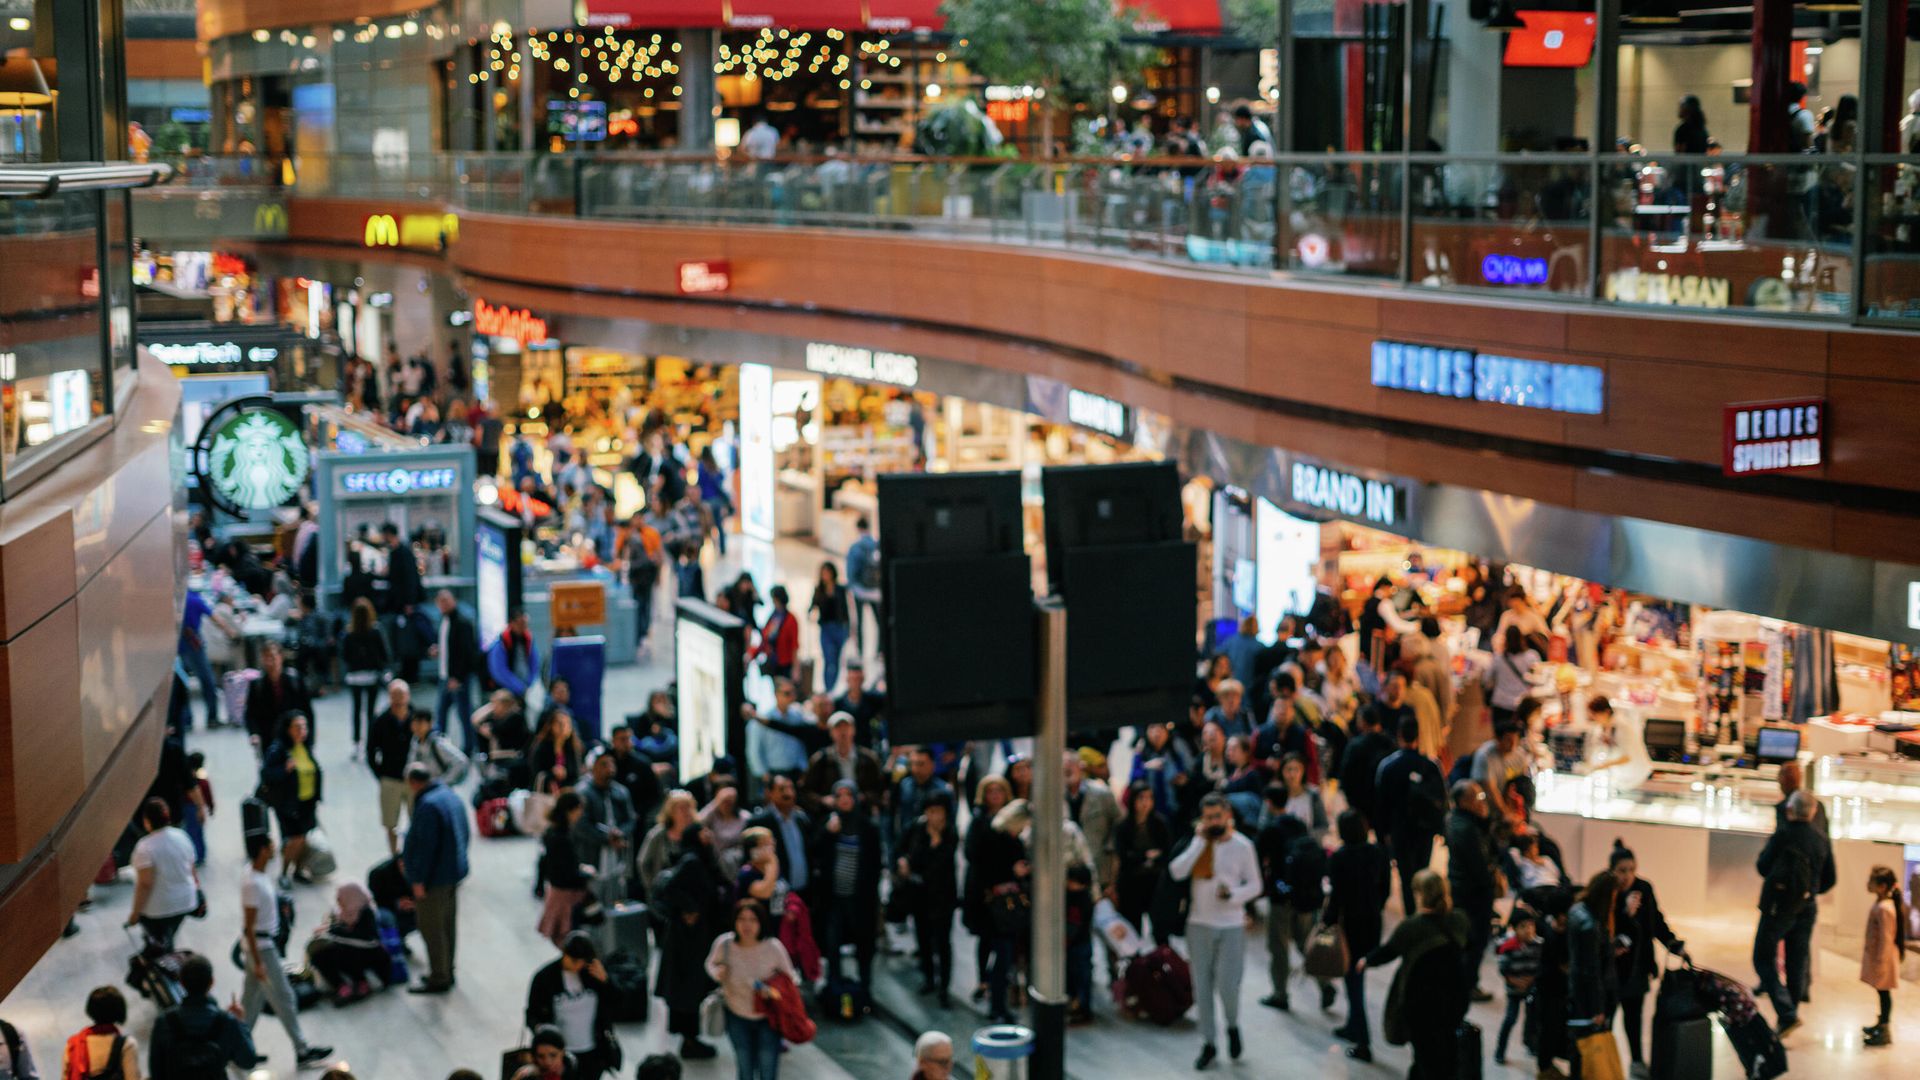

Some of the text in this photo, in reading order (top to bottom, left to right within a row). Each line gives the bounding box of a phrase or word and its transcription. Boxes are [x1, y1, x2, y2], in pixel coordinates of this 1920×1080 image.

[1736, 405, 1818, 441] HEROES
[1733, 441, 1789, 472] SPORTS
[1292, 462, 1395, 526] BRAND IN
